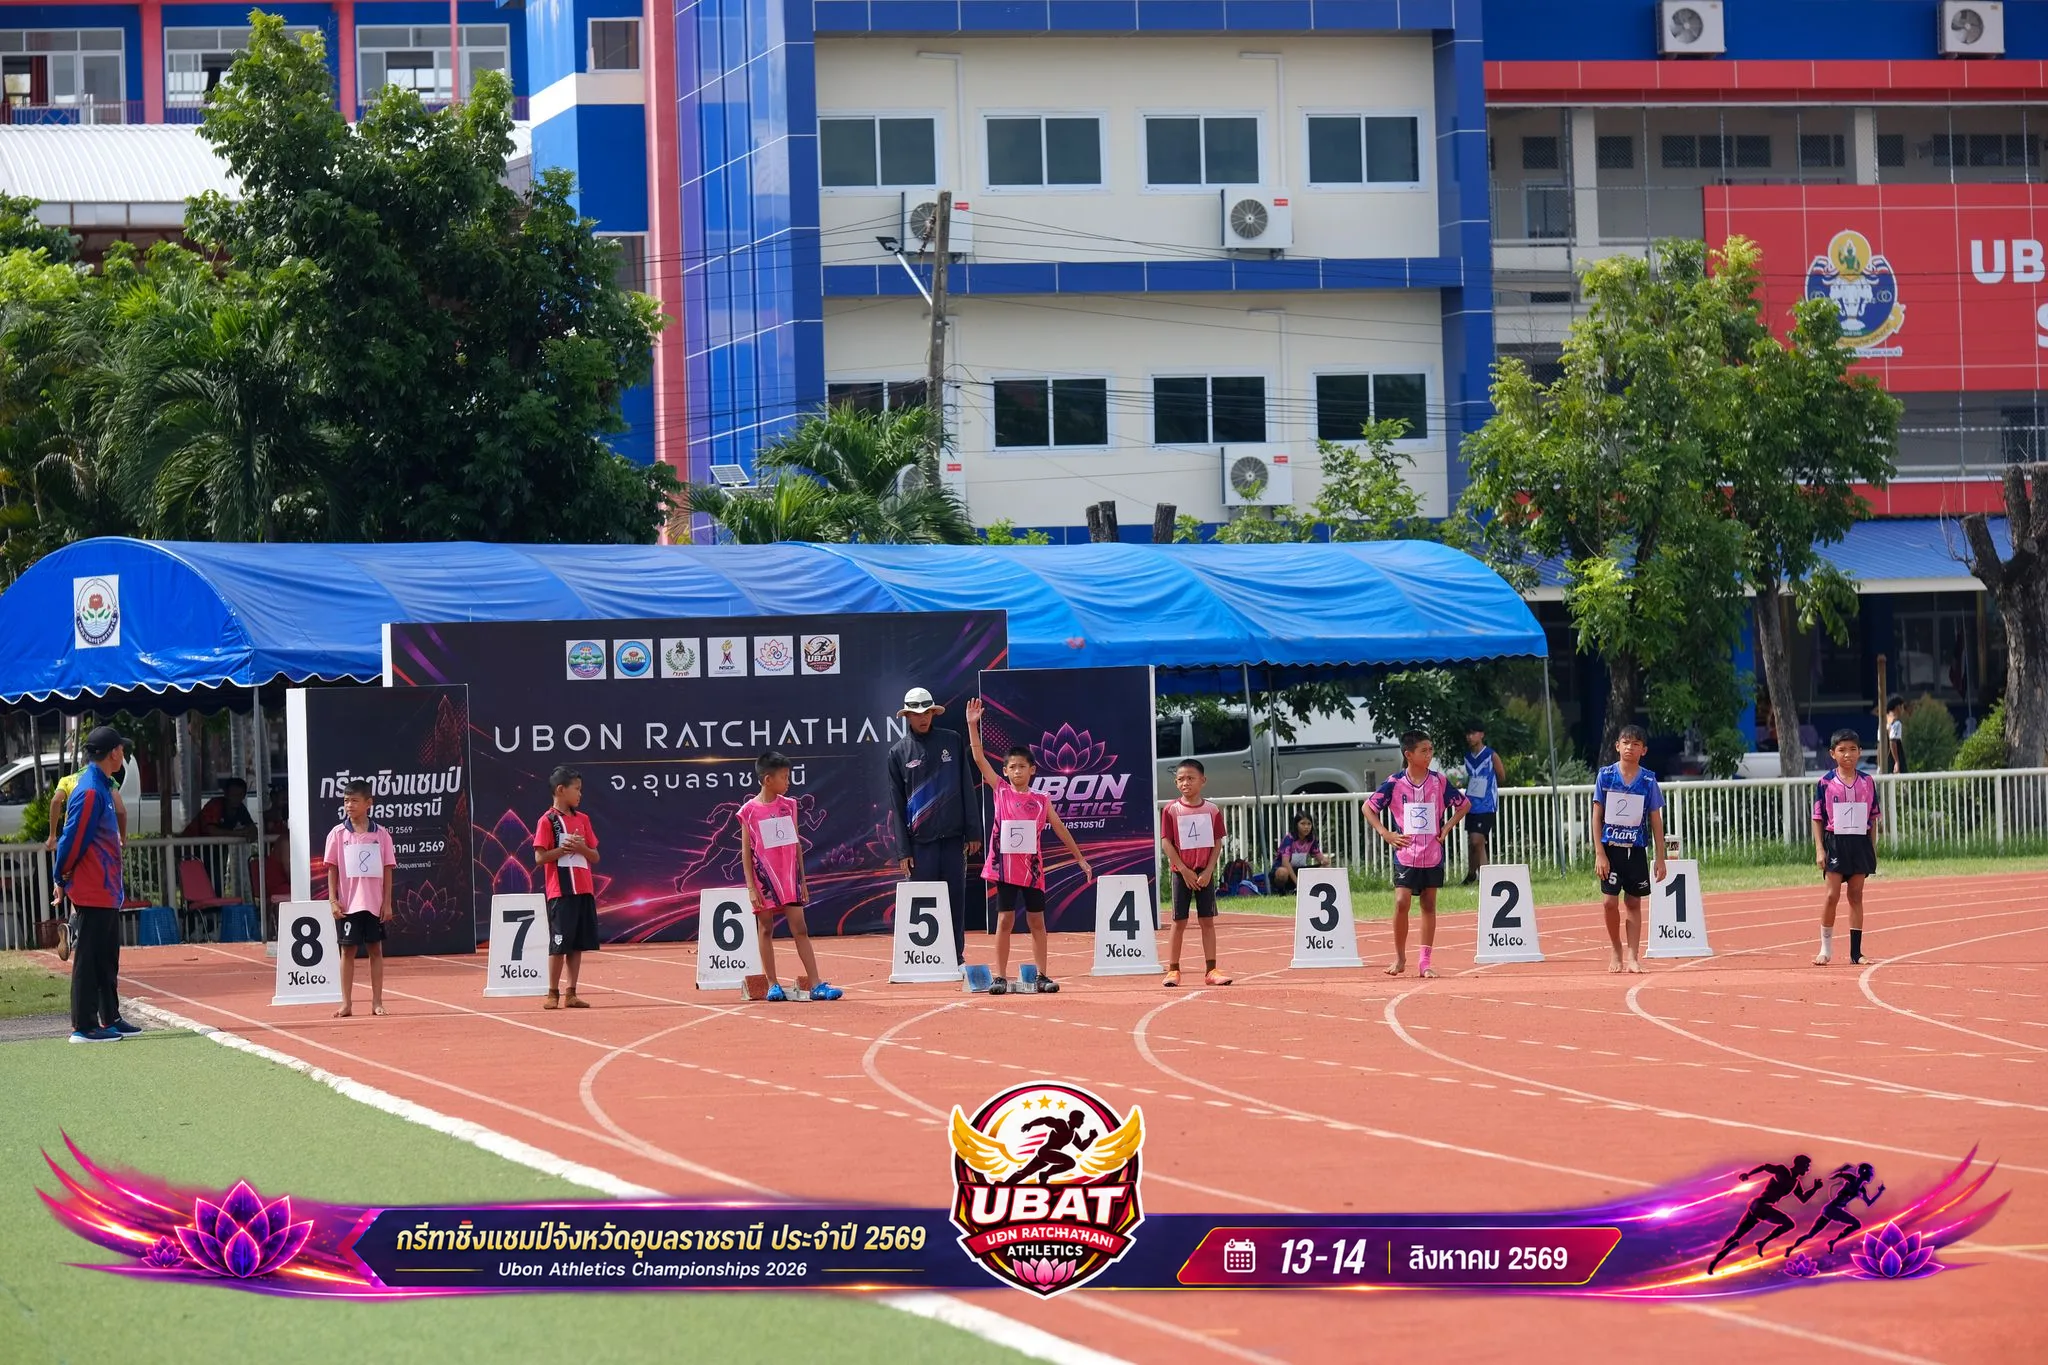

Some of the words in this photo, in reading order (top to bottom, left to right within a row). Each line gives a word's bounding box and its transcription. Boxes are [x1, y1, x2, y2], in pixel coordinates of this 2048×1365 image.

[807, 654, 834, 662] UBAT
[495, 723, 622, 753] UBON
[646, 714, 907, 750] RATCHATHAN
[319, 766, 463, 799] กรีาชิงแชมป์
[610, 763, 806, 796] จ.อุบลราชนี
[1052, 801, 1128, 817] LETICS
[1615, 798, 1631, 817] 2
[1843, 806, 1860, 829] 1
[1410, 807, 1428, 829] 3
[395, 826, 413, 834] 2569
[1010, 827, 1025, 848] 5
[1187, 821, 1201, 841] 4
[1606, 826, 1639, 842] Chang
[419, 840, 445, 853] 2569
[358, 850, 371, 873] 8
[1608, 871, 1618, 885] 5
[1309, 883, 1340, 932] 3
[1491, 880, 1522, 929] 2
[1666, 873, 1687, 922] 1
[908, 896, 940, 947] 5
[1109, 890, 1140, 940] 4
[343, 921, 352, 937] 9
[503, 909, 535, 961] 7
[712, 901, 745, 951] 6
[1658, 925, 1692, 939] Nelco
[291, 916, 324, 968] 8
[1488, 933, 1524, 947] Nelco
[904, 950, 941, 965] Nelco
[1105, 943, 1142, 958] Nelco
[500, 964, 538, 979] Nelco
[709, 954, 746, 969] Nelco
[287, 971, 327, 986] Nelco
